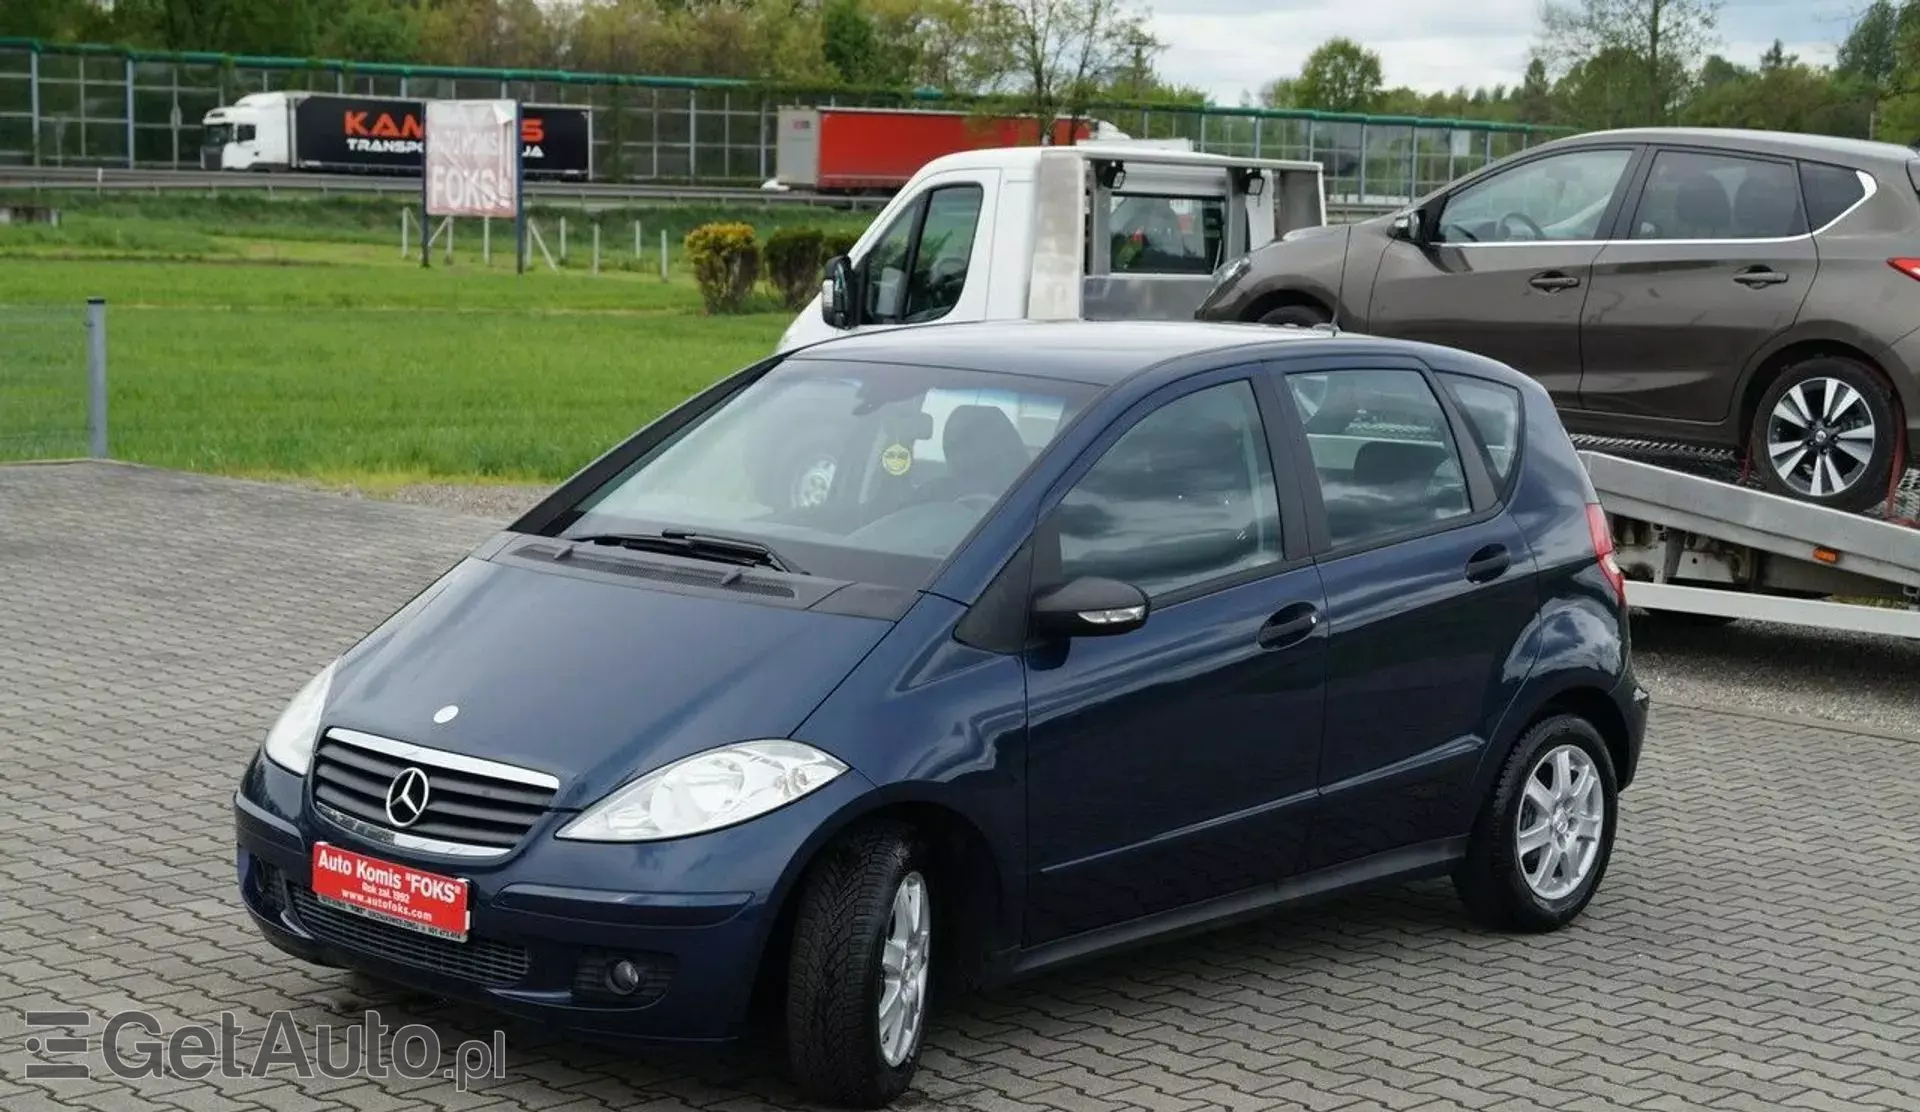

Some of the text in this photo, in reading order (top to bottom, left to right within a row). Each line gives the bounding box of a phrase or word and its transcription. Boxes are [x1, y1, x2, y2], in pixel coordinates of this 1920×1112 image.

[318, 849, 461, 904] Auto Komis "FOKS"
[340, 889, 433, 922] www.autofoks.com
